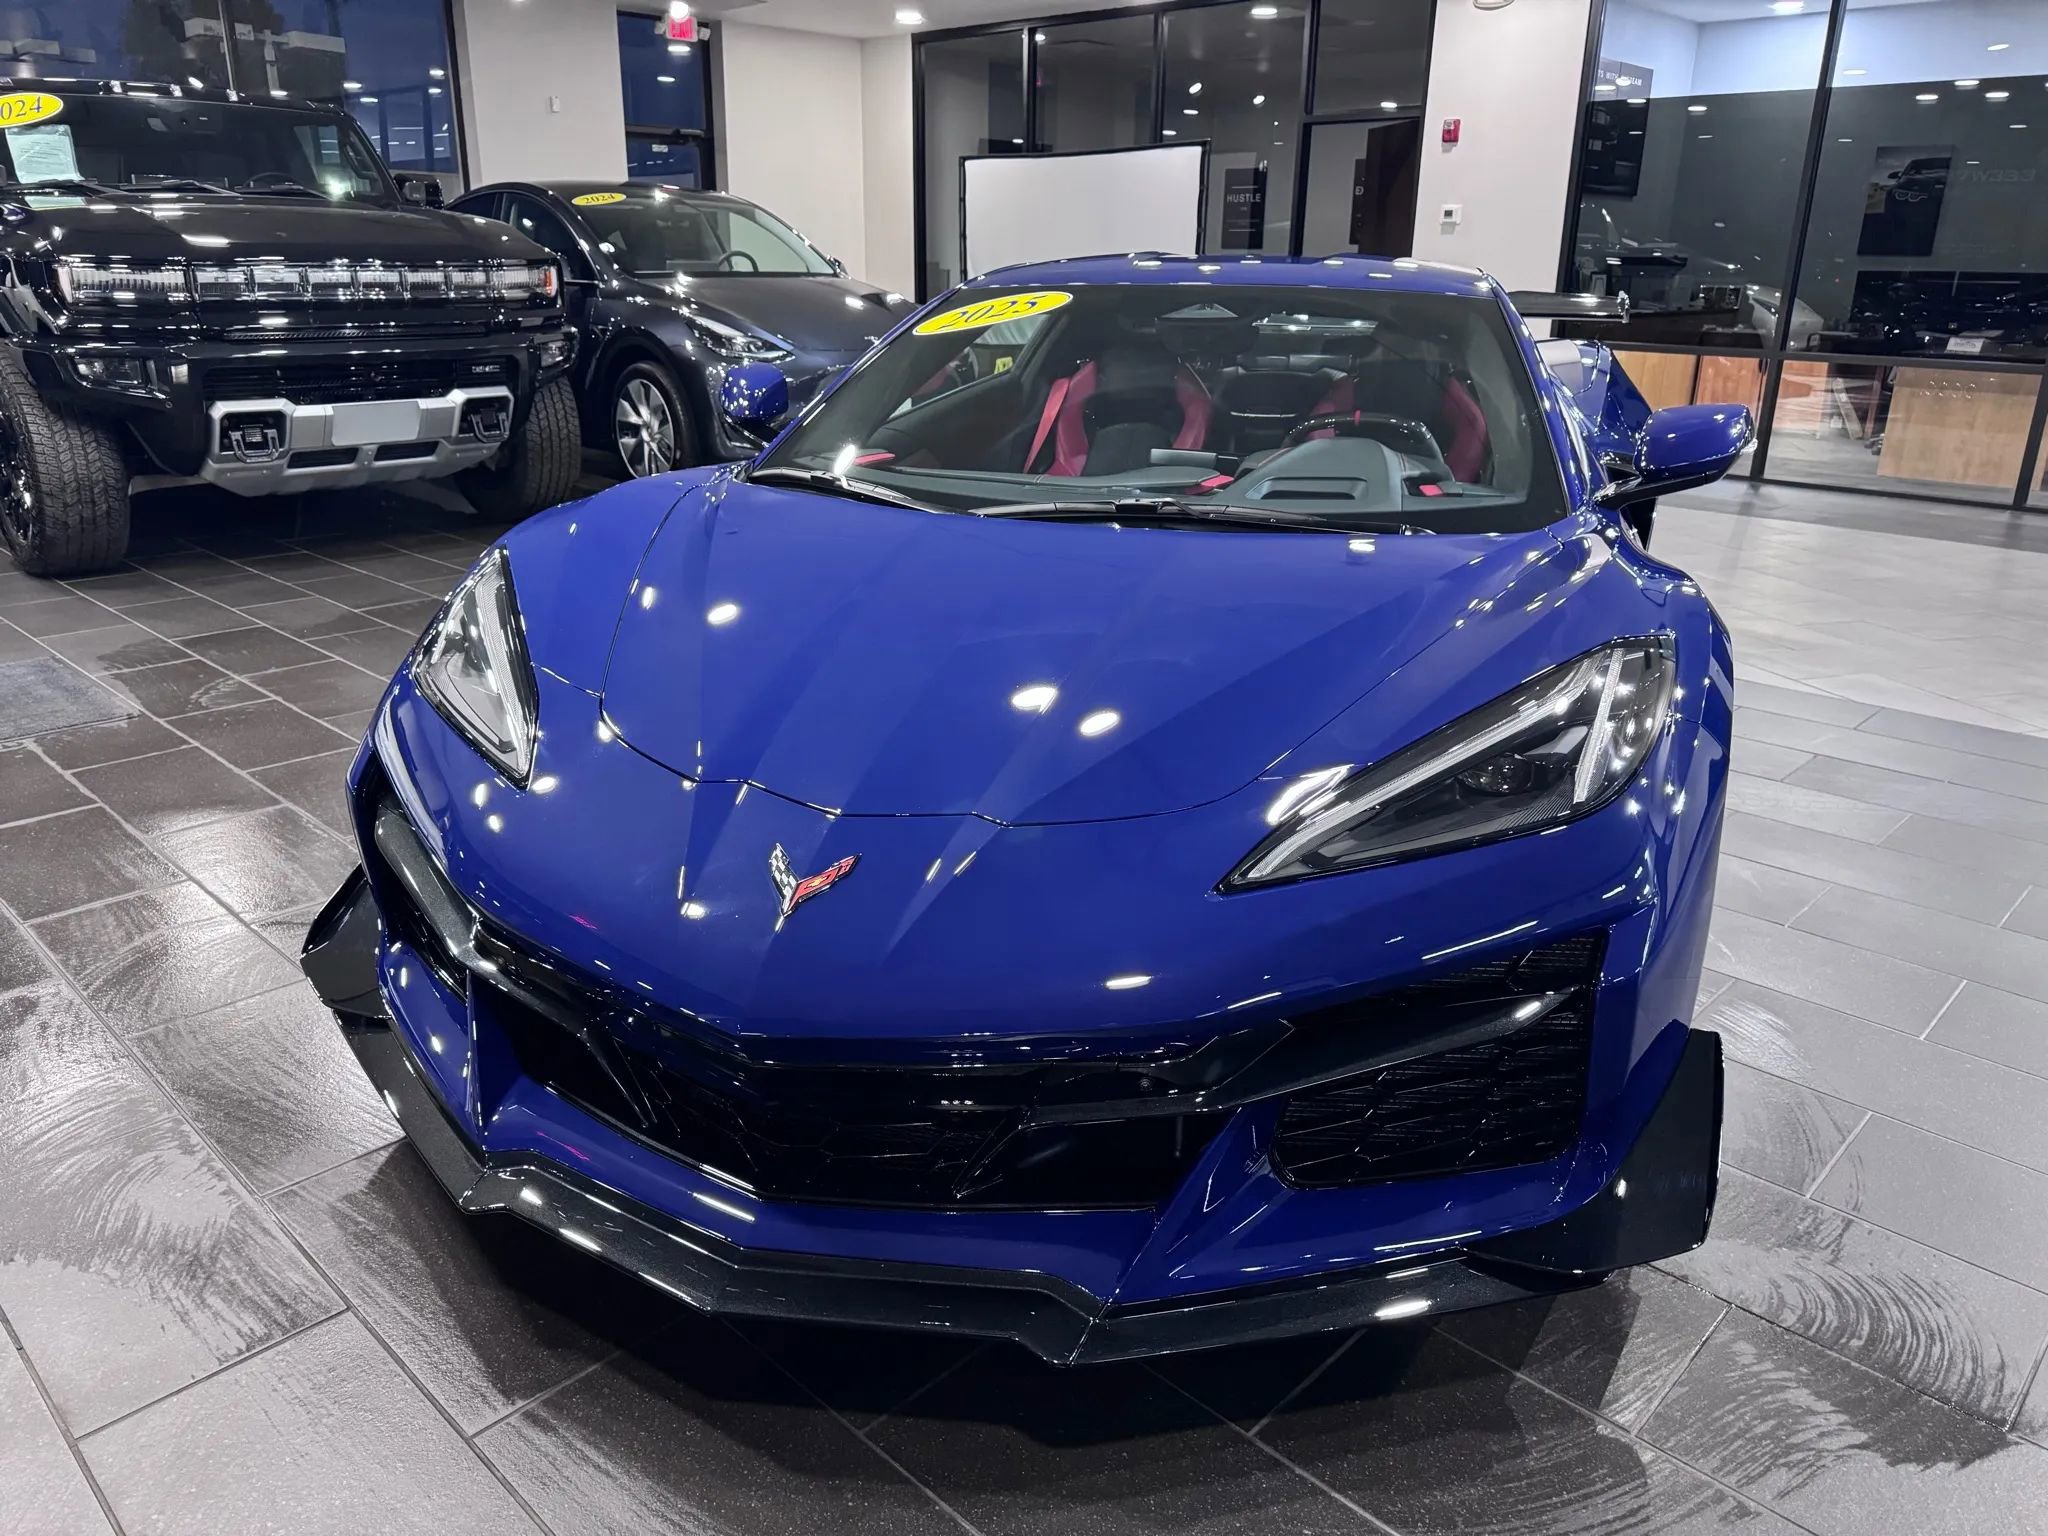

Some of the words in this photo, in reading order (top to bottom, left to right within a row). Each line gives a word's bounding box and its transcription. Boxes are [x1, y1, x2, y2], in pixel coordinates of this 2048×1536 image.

[584, 193, 616, 204] 2024
[1227, 193, 1262, 203] HUSTLE
[935, 294, 1048, 331] 2025
